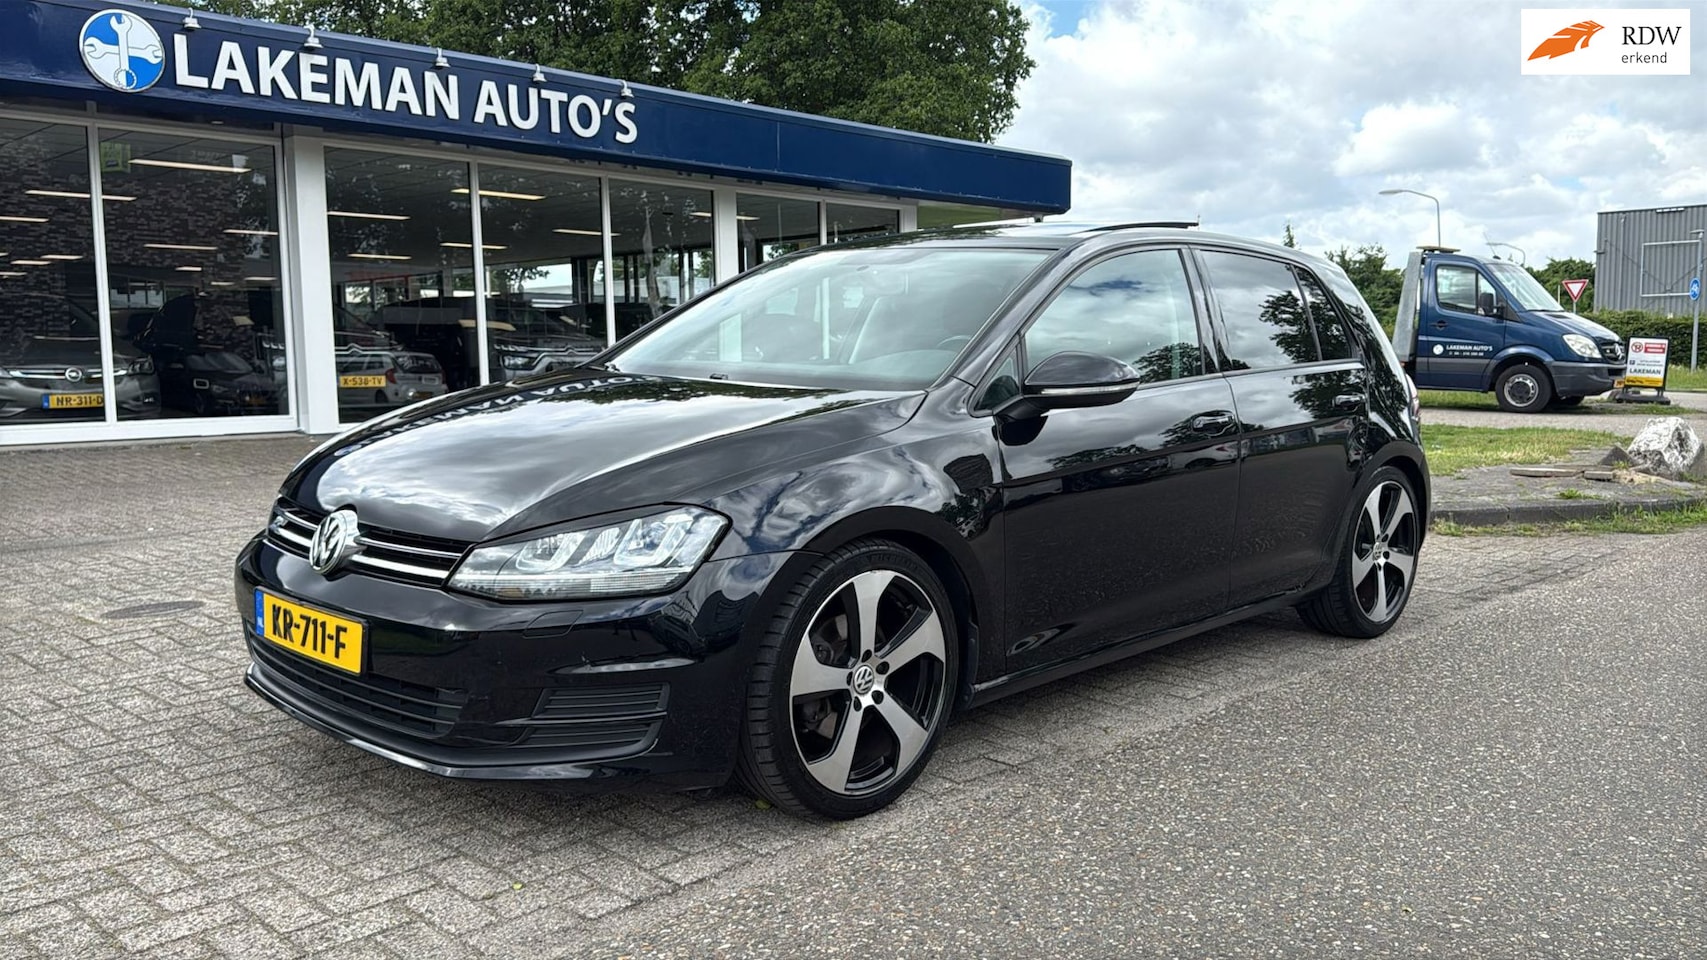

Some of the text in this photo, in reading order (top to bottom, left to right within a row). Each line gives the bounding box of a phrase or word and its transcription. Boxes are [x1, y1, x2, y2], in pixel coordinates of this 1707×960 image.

[174, 34, 638, 144] LAKEMAN AUTO'S
[343, 377, 383, 386] X-538-TV
[272, 604, 347, 659] KR-711-F
